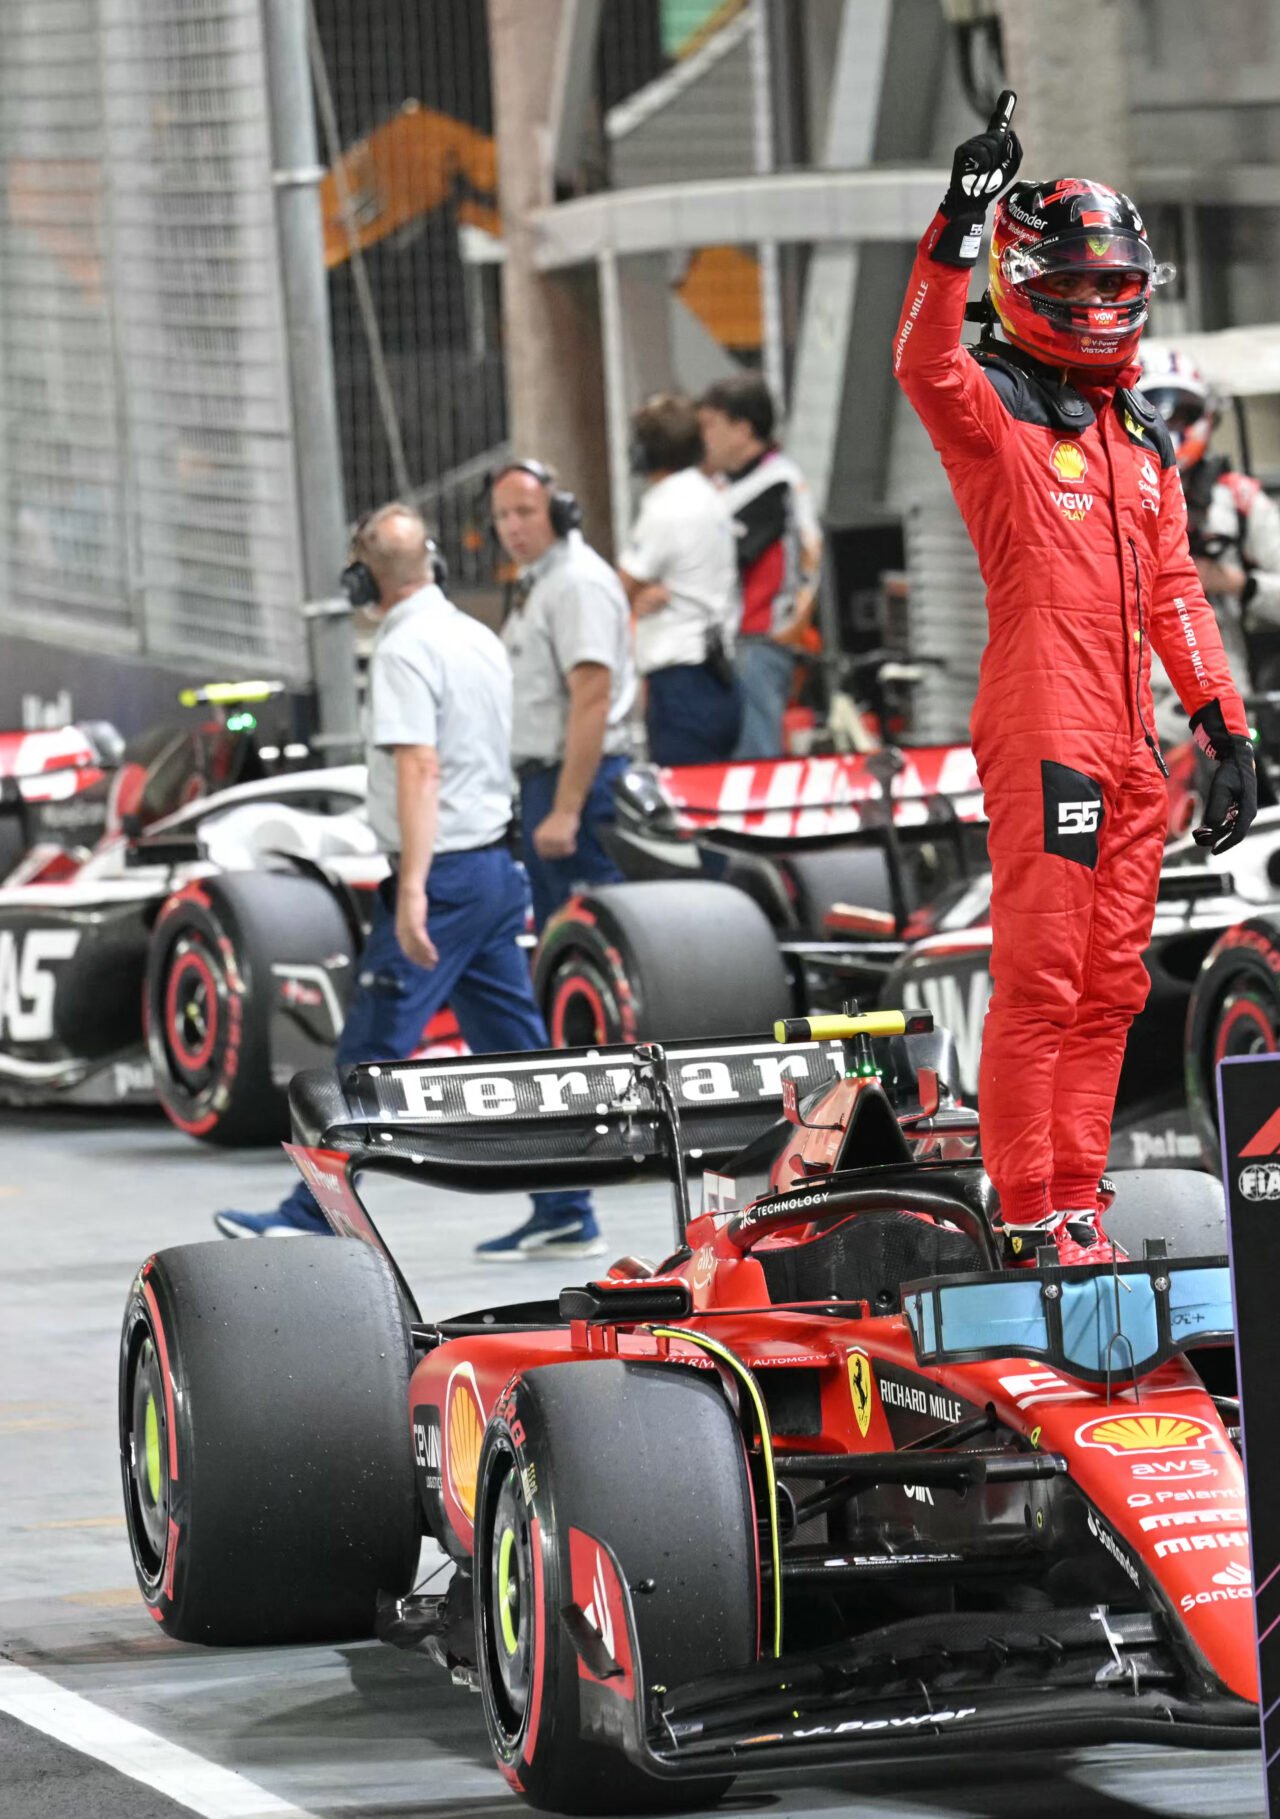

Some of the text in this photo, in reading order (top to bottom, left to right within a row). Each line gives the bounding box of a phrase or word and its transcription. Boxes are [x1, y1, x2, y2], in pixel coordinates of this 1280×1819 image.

[970, 224, 983, 236] 55
[910, 280, 929, 319] MILLE
[1093, 311, 1114, 321] VGW
[1092, 339, 1119, 347] V-Power
[1050, 491, 1093, 511] VGW
[1062, 511, 1086, 521] PLAY
[1173, 597, 1209, 687] RICHARD MILLE
[1057, 800, 1101, 835] 55
[757, 1192, 830, 1216] TECHNOLOGY
[697, 1247, 714, 1271] aws
[880, 1379, 962, 1424] RICHARD MILLE
[1130, 1459, 1211, 1475] aws
[1095, 1518, 1140, 1590] Santander
[793, 1707, 977, 1737] V-Power
